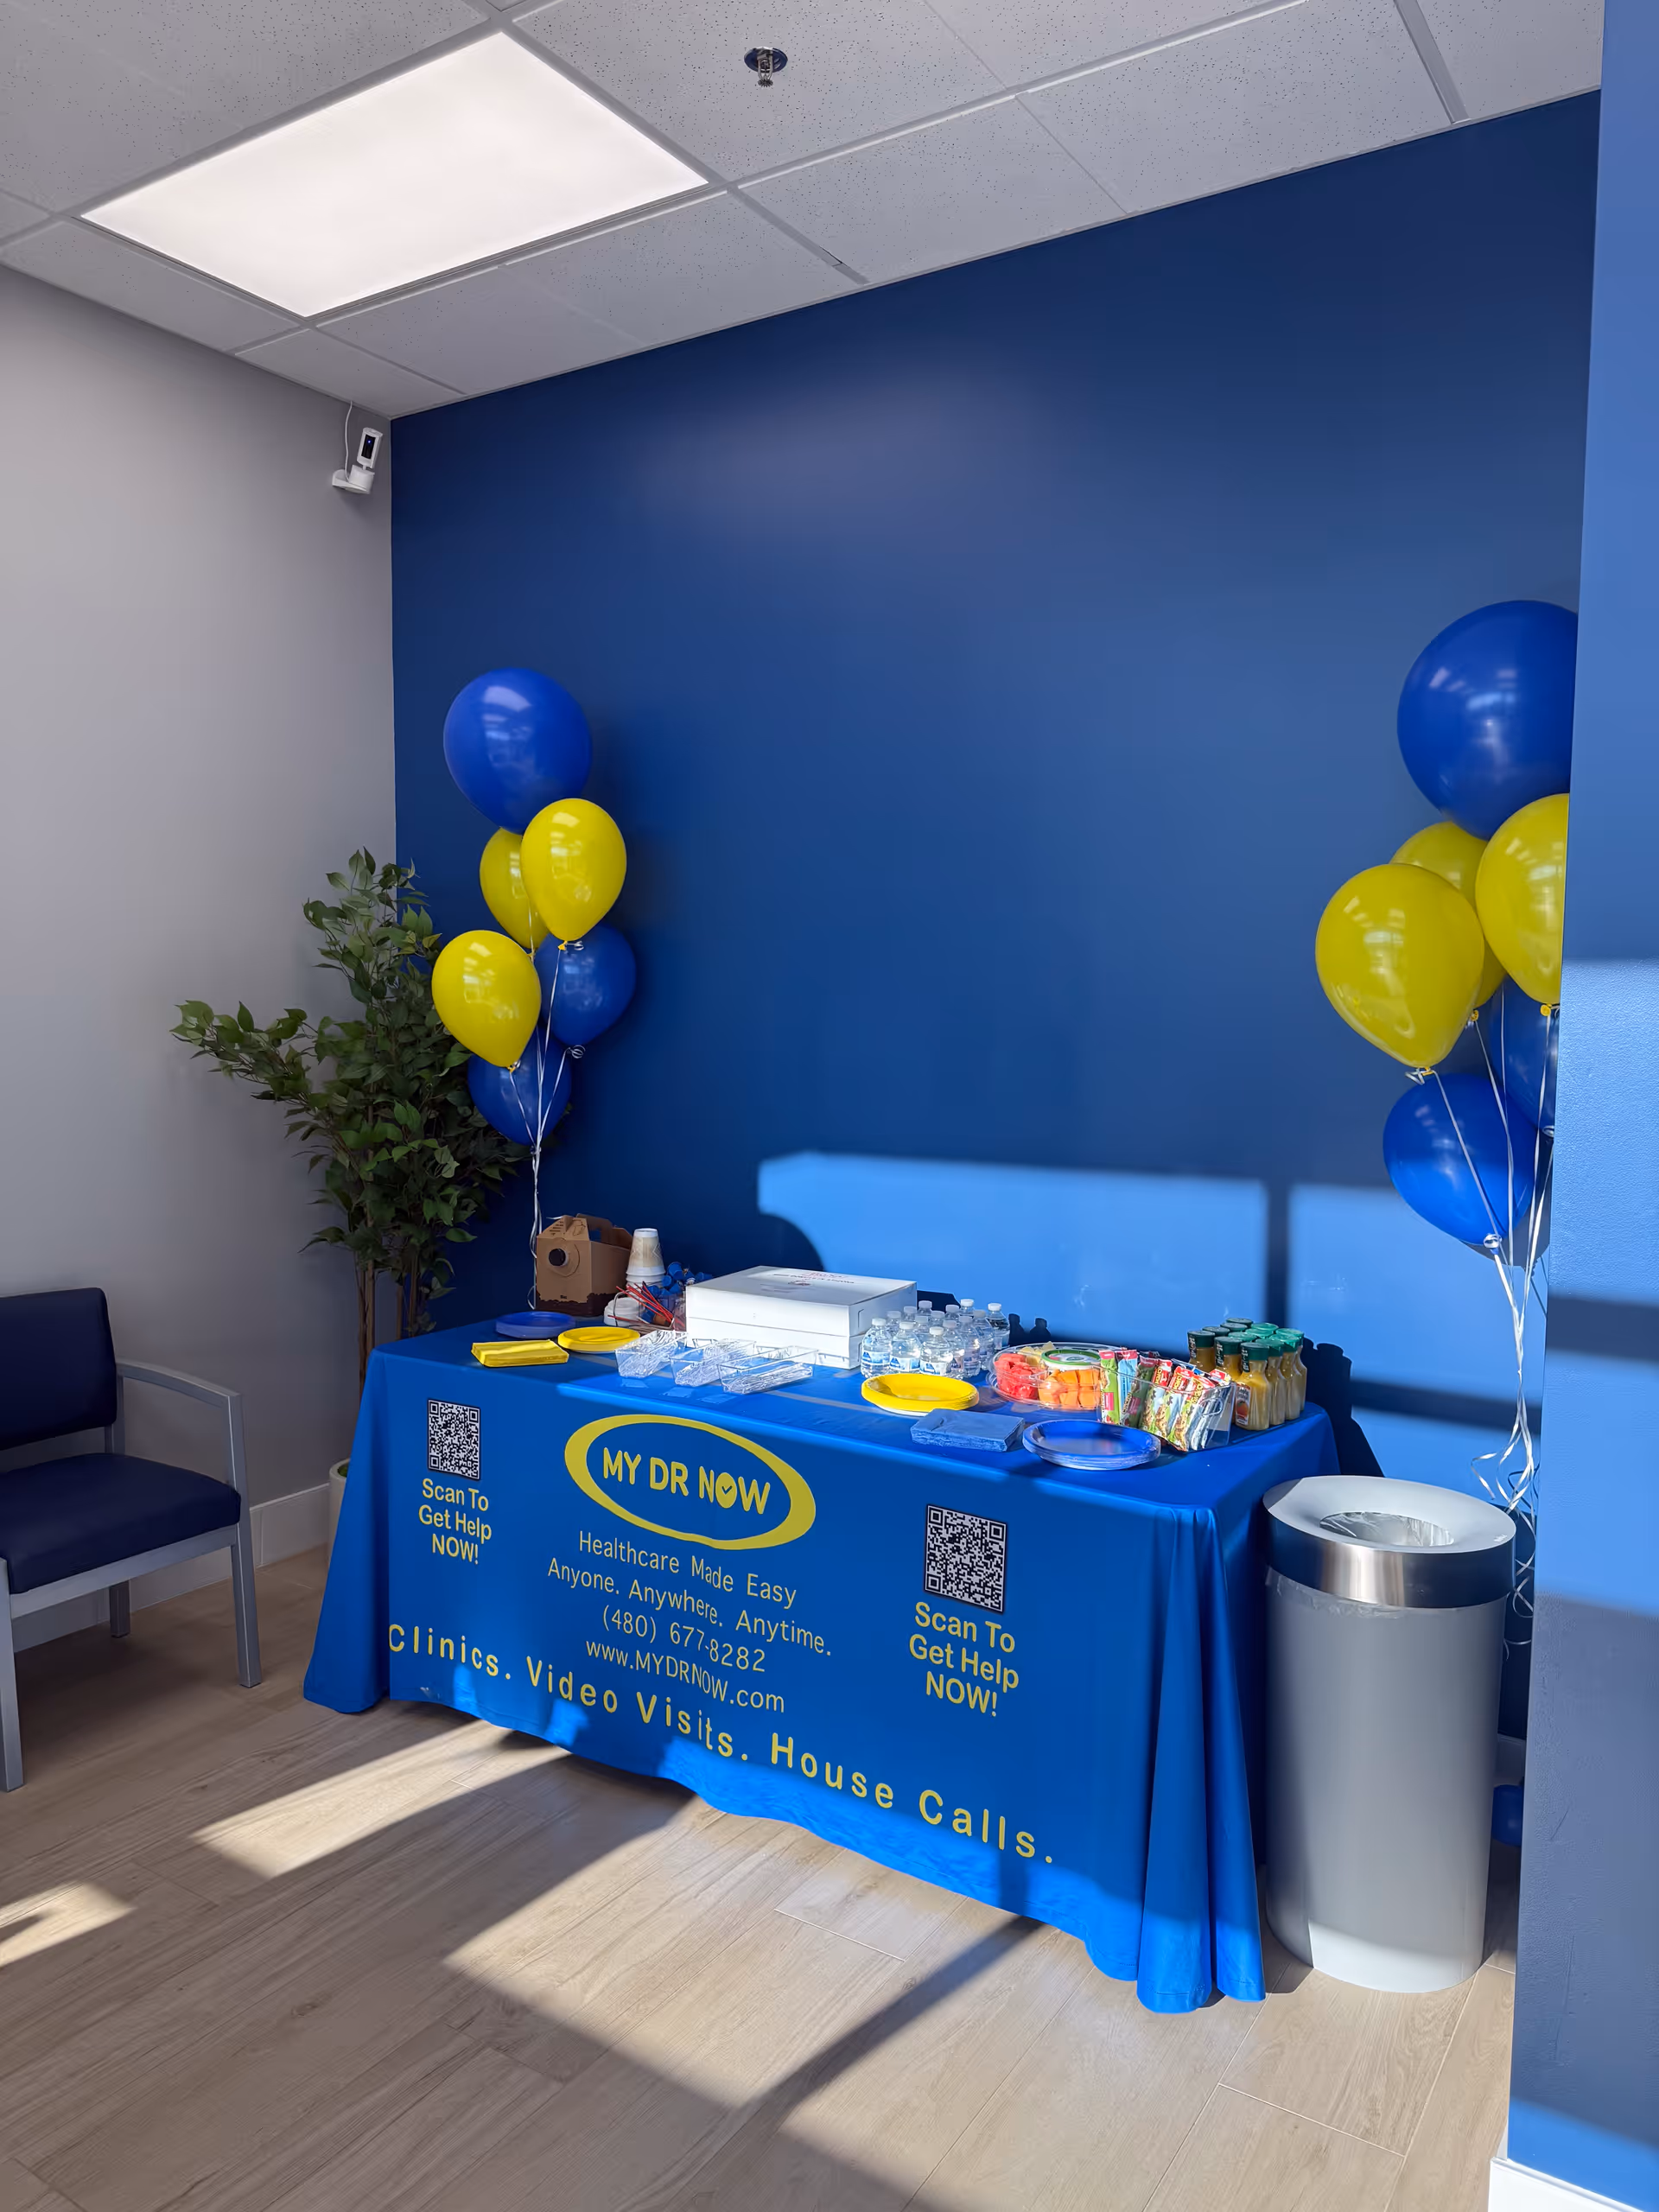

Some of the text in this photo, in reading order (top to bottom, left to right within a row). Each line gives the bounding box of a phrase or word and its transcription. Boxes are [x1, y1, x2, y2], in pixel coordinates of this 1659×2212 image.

[422, 1478, 488, 1512] Scan To
[604, 1448, 771, 1515] MY DR NOW
[418, 1504, 492, 1544] Get Help
[432, 1533, 479, 1565] NOW!
[579, 1531, 797, 1609] Healthcare Made Easy
[548, 1558, 832, 1656] Anyone. Anywhere. Anytime.
[603, 1605, 766, 1672] (480) 677-8282
[915, 1601, 1015, 1653] Scan To
[586, 1642, 785, 1713] www.MYDRNOW.com
[909, 1634, 1019, 1694] Get Help
[925, 1671, 997, 1717] NOW!
[389, 1624, 1052, 1864] Clinics. Video Visits. House Calls.
